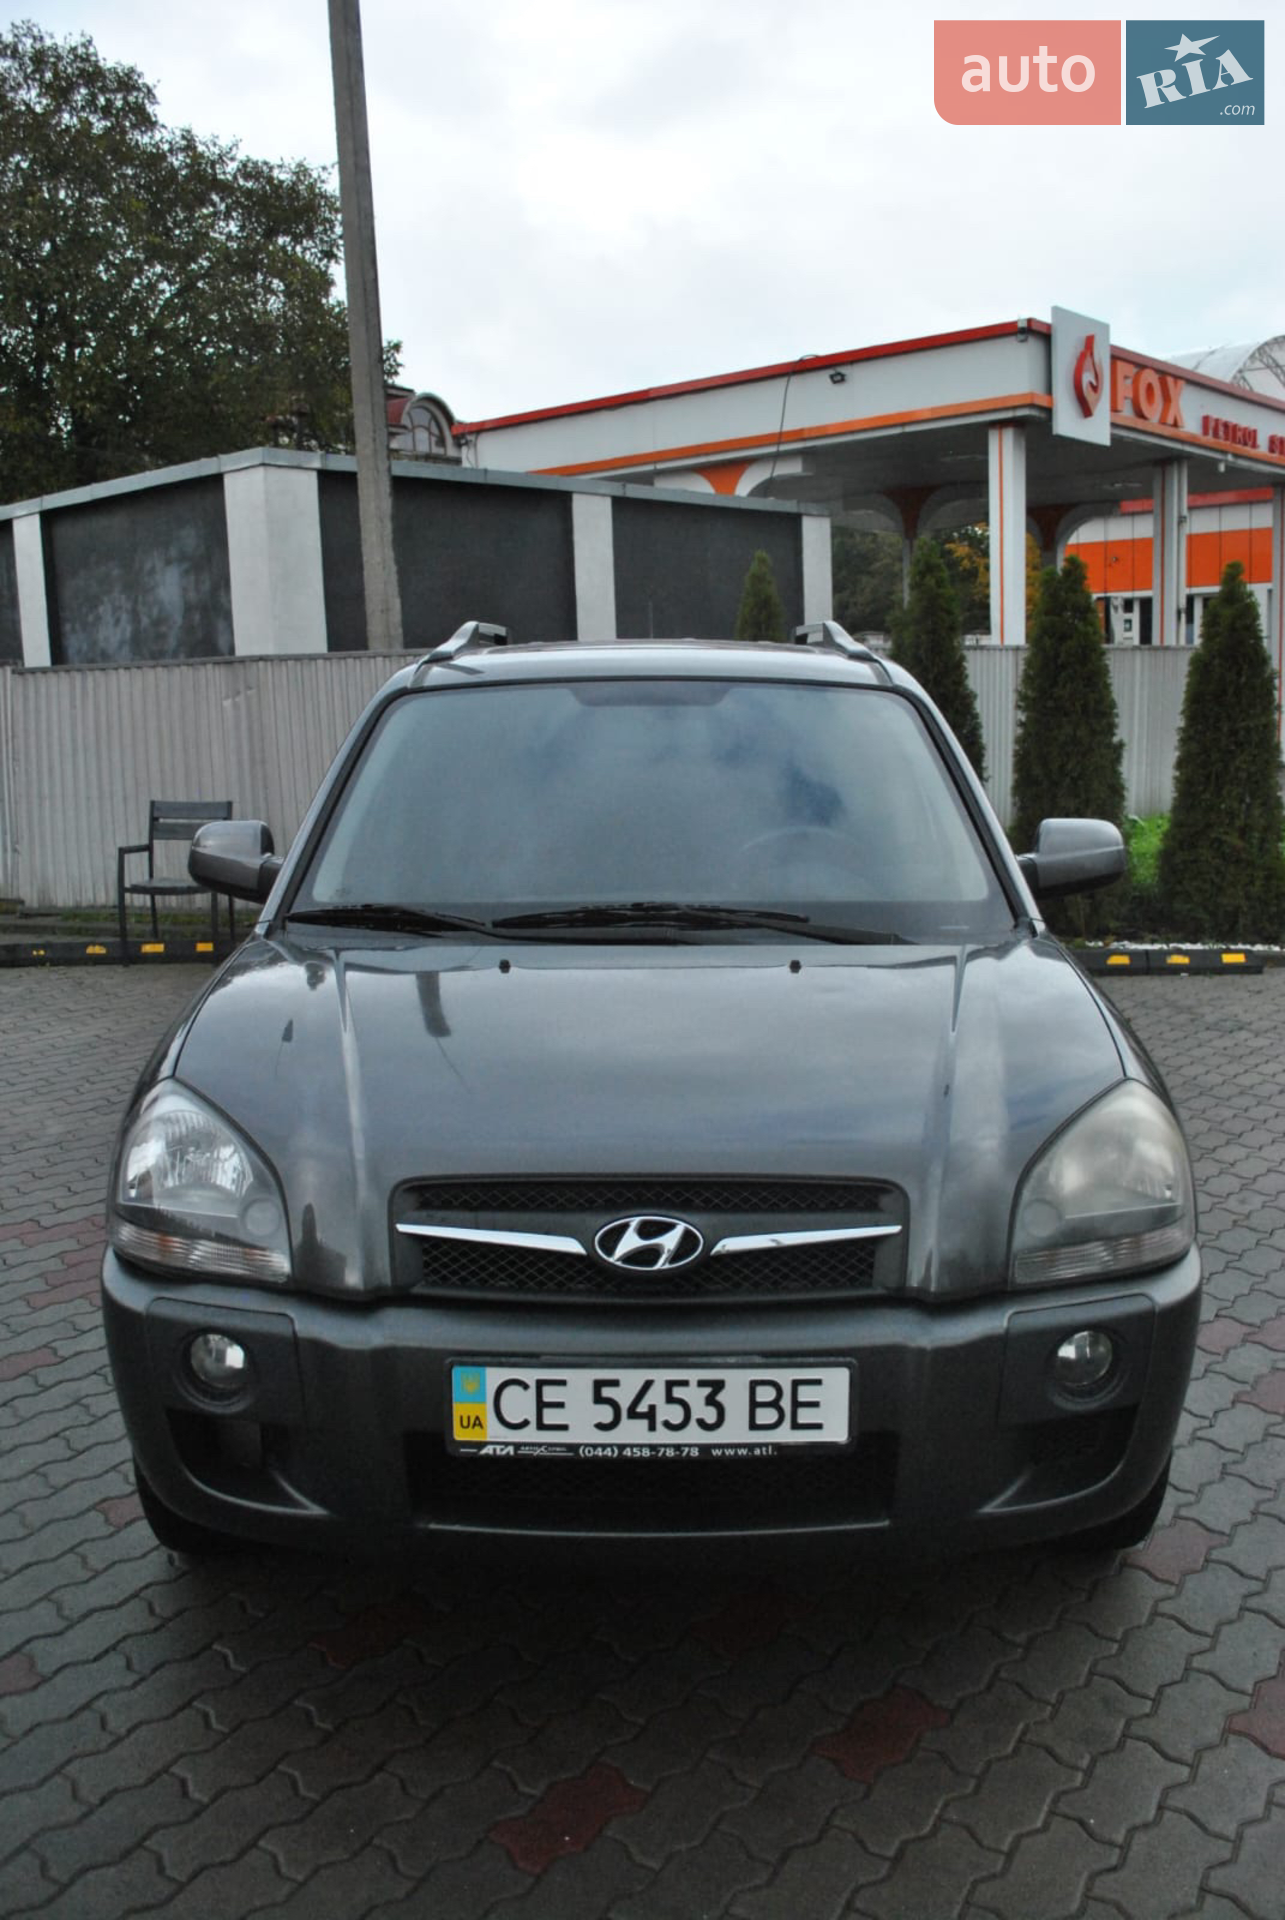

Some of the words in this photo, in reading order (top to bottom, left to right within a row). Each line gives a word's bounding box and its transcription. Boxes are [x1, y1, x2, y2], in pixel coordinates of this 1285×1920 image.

[1110, 358, 1185, 428] FOX
[1202, 414, 1259, 449] PETROL
[459, 1415, 483, 1429] UA
[493, 1378, 569, 1431] CE
[593, 1378, 726, 1432] 5453
[748, 1378, 823, 1431] BE
[579, 1445, 618, 1457] (044)
[622, 1446, 700, 1458] 458-78-78
